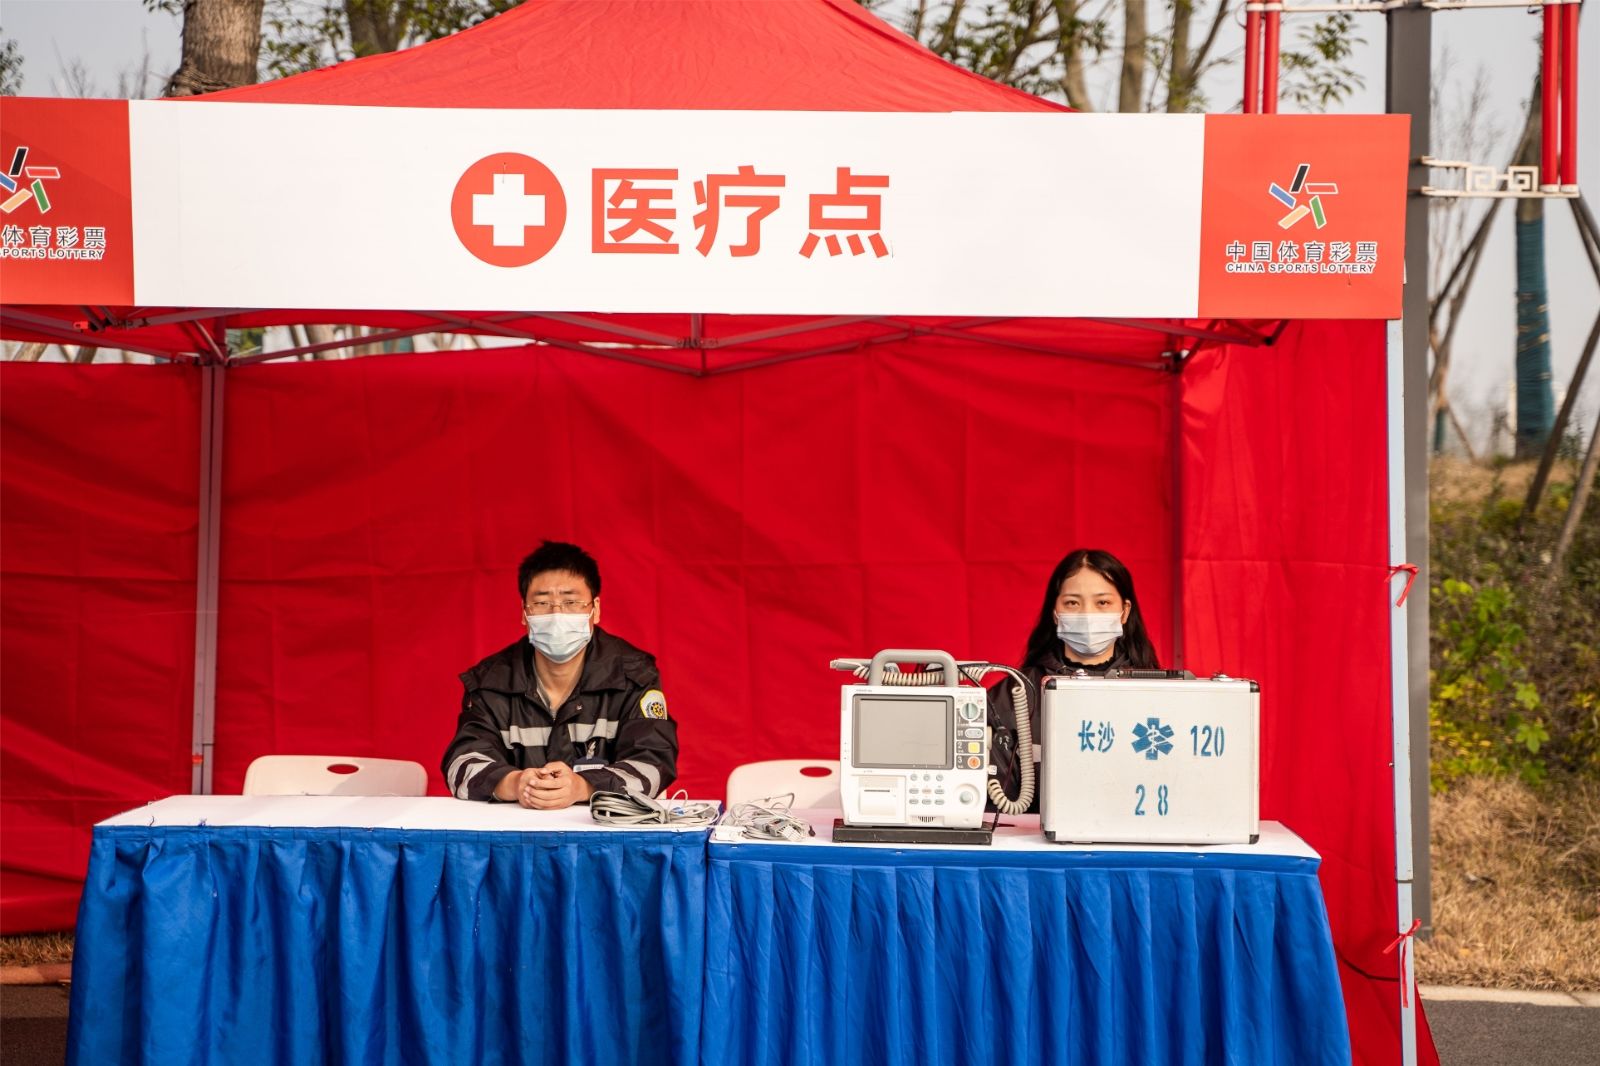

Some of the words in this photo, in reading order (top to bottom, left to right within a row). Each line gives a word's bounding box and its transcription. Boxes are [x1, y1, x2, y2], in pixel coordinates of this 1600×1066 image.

[592, 165, 890, 259] 医疗点
[2, 225, 105, 248] 体育彩票
[0, 248, 45, 258] PORTS
[48, 249, 104, 259] LOTTERY
[1226, 241, 1378, 262] 中国体育彩票
[1226, 263, 1264, 274] CHINA
[1269, 263, 1318, 274] SPORTS
[1322, 263, 1374, 274] LOTTERY
[1078, 720, 1115, 753] 长沙
[1190, 725, 1225, 757] 120
